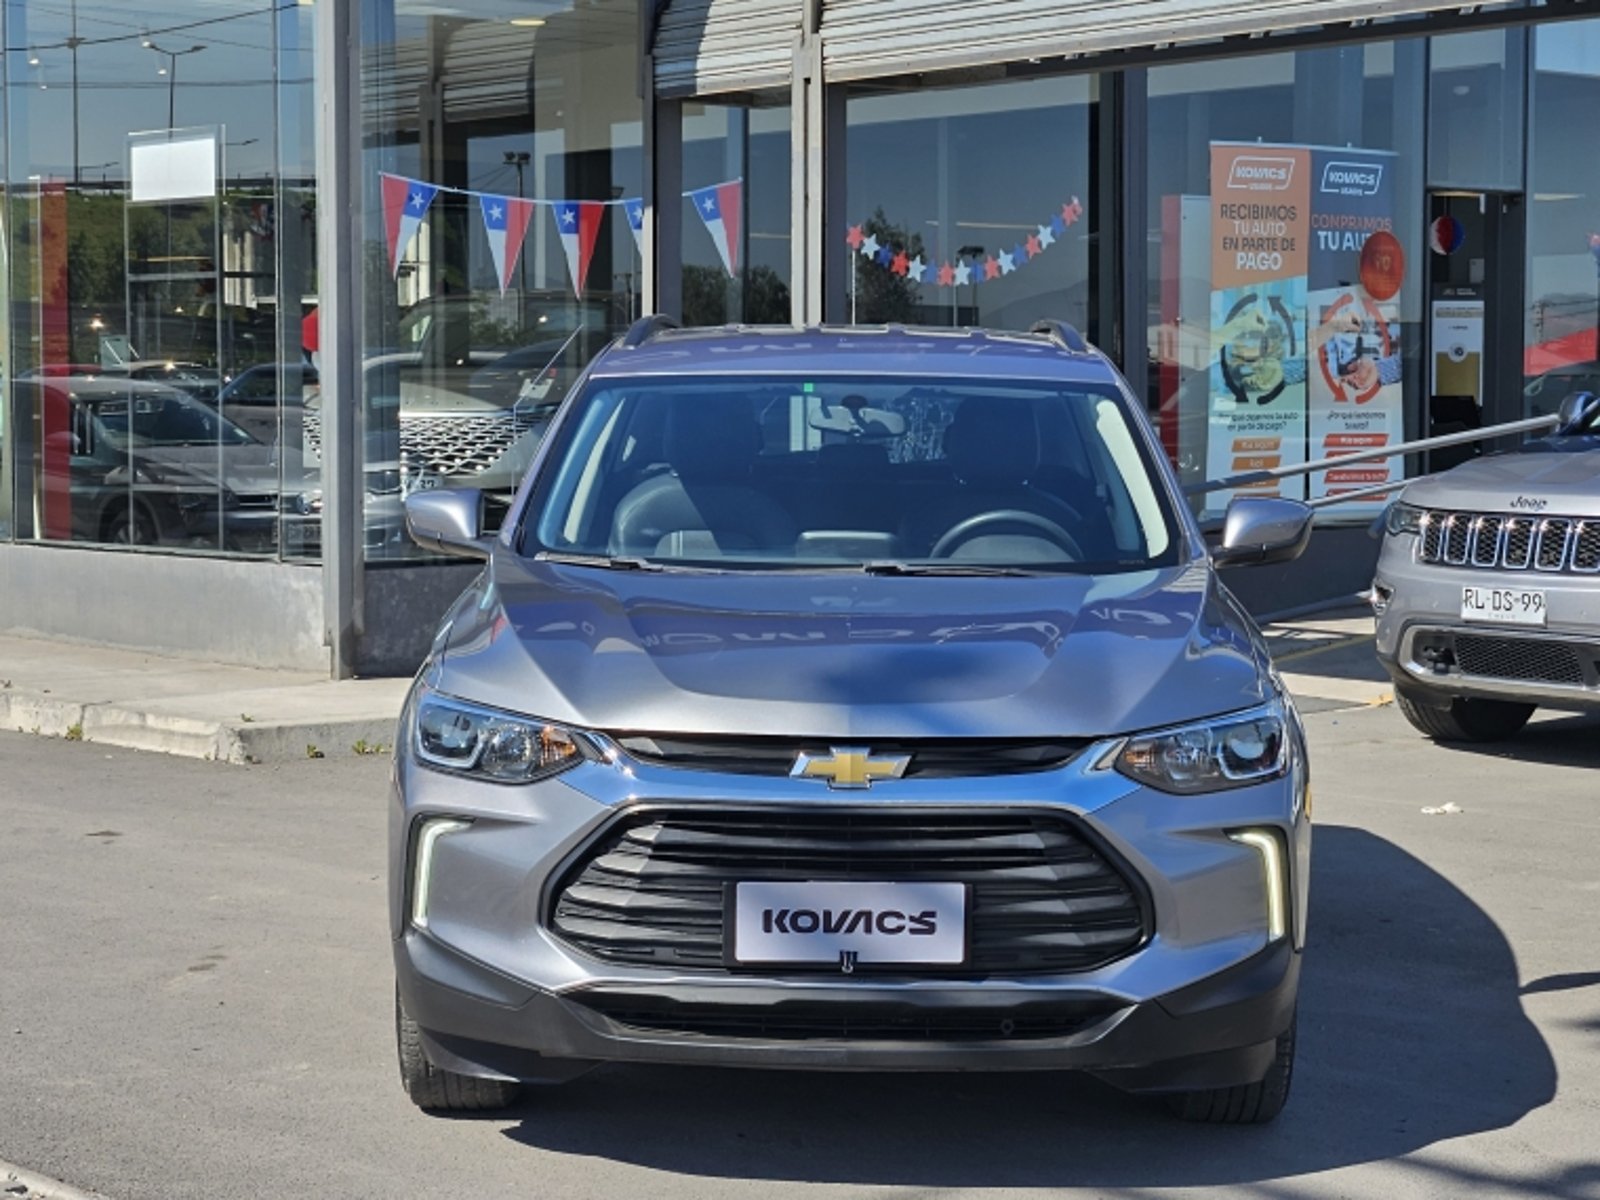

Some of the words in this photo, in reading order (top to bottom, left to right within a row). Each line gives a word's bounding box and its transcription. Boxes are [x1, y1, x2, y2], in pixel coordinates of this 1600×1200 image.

[1235, 166, 1288, 180] KOVACS
[1328, 171, 1376, 186] KOVACS
[1220, 203, 1298, 221] RECIBIMOS
[1233, 220, 1249, 236] TU
[1251, 221, 1288, 237] AUTO
[1222, 237, 1239, 251] EN
[1242, 237, 1278, 251] PARTE
[1280, 237, 1296, 252] DE
[1317, 230, 1340, 251] TU
[1236, 252, 1283, 271] PAGO
[1510, 495, 1547, 511] Jeep
[762, 908, 937, 936] KOVACS
